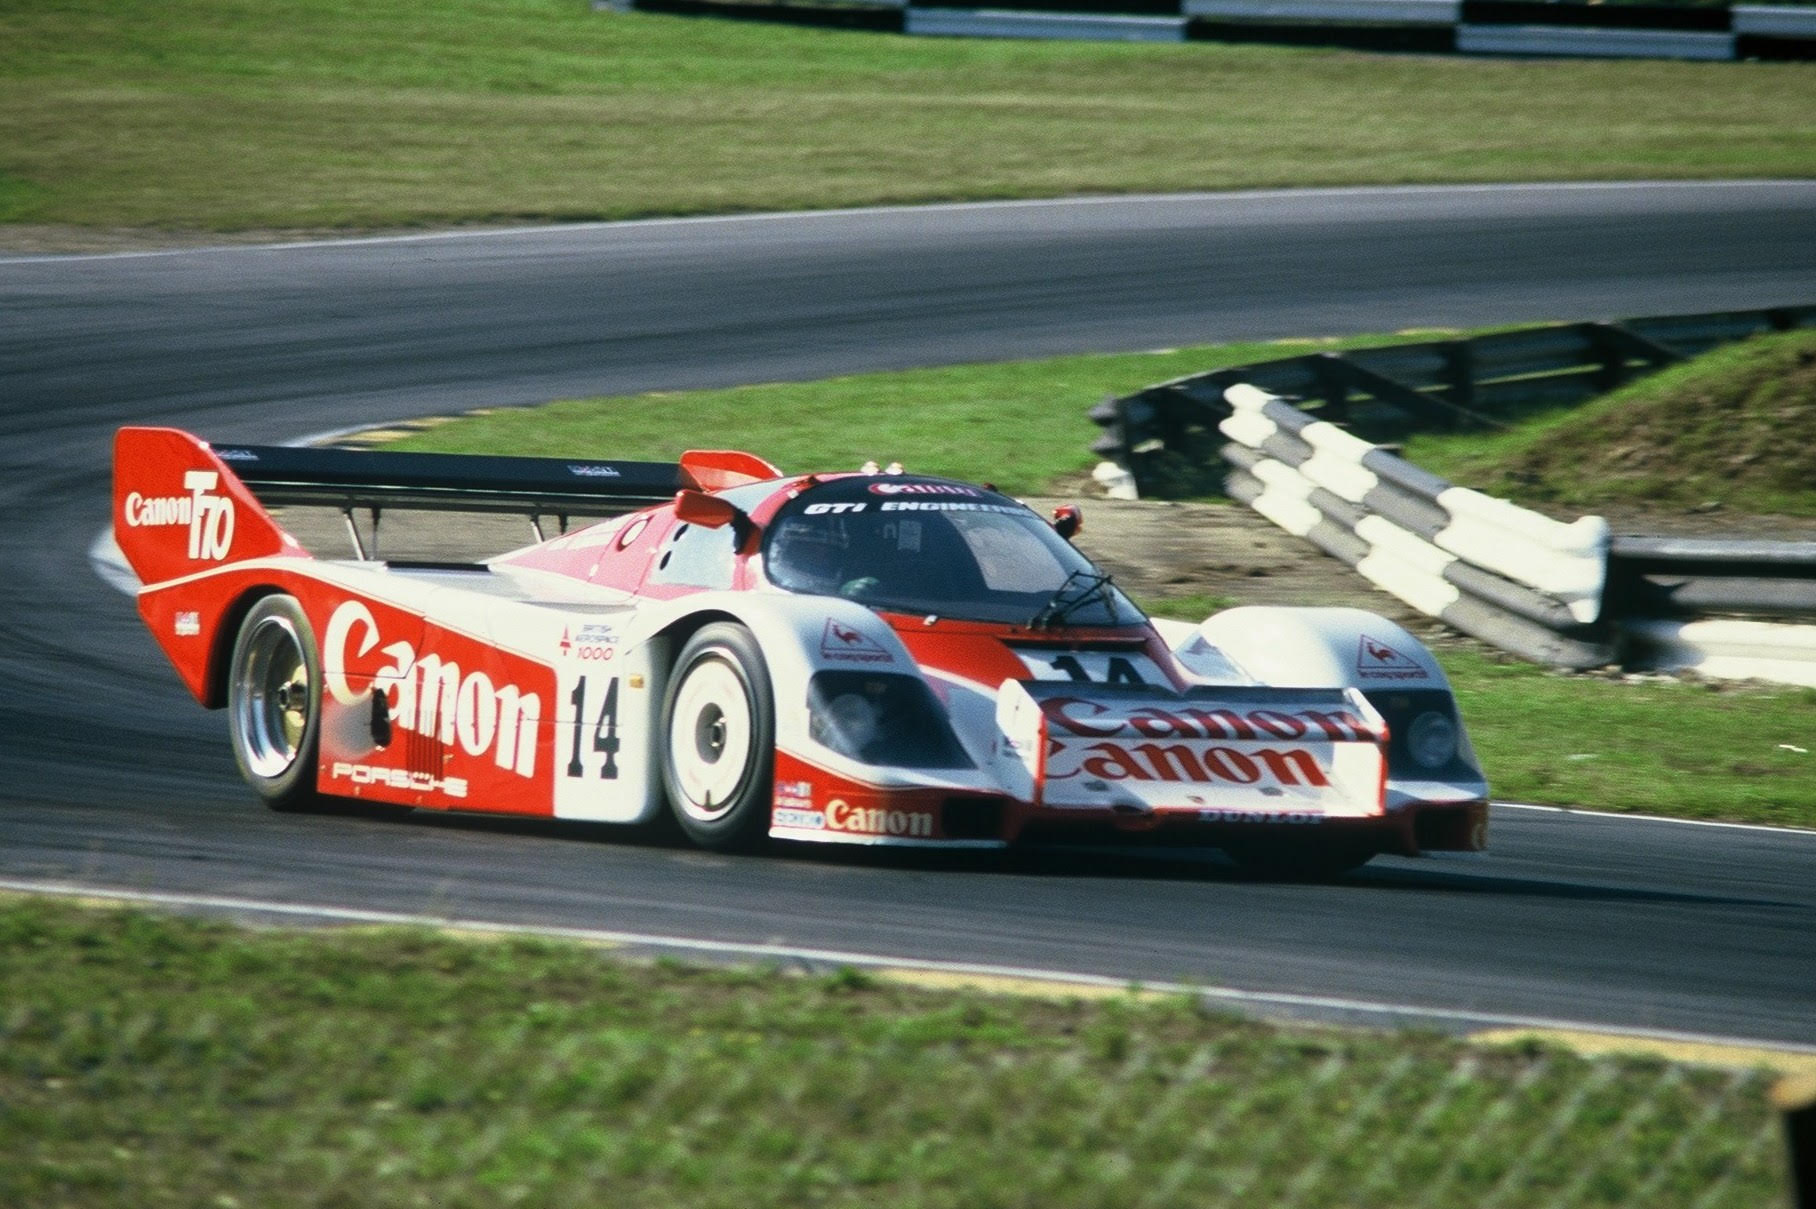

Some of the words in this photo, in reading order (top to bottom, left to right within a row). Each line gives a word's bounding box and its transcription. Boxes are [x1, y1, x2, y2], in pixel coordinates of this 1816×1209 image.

[125, 491, 193, 526] Canon
[184, 471, 234, 560] T70
[804, 502, 867, 515] GTI
[577, 646, 614, 661] 1000
[323, 600, 541, 778] Canon
[566, 675, 621, 780] 14
[1038, 697, 1378, 742] Canon
[332, 762, 469, 798] PORSCHE
[825, 798, 933, 836] Canon
